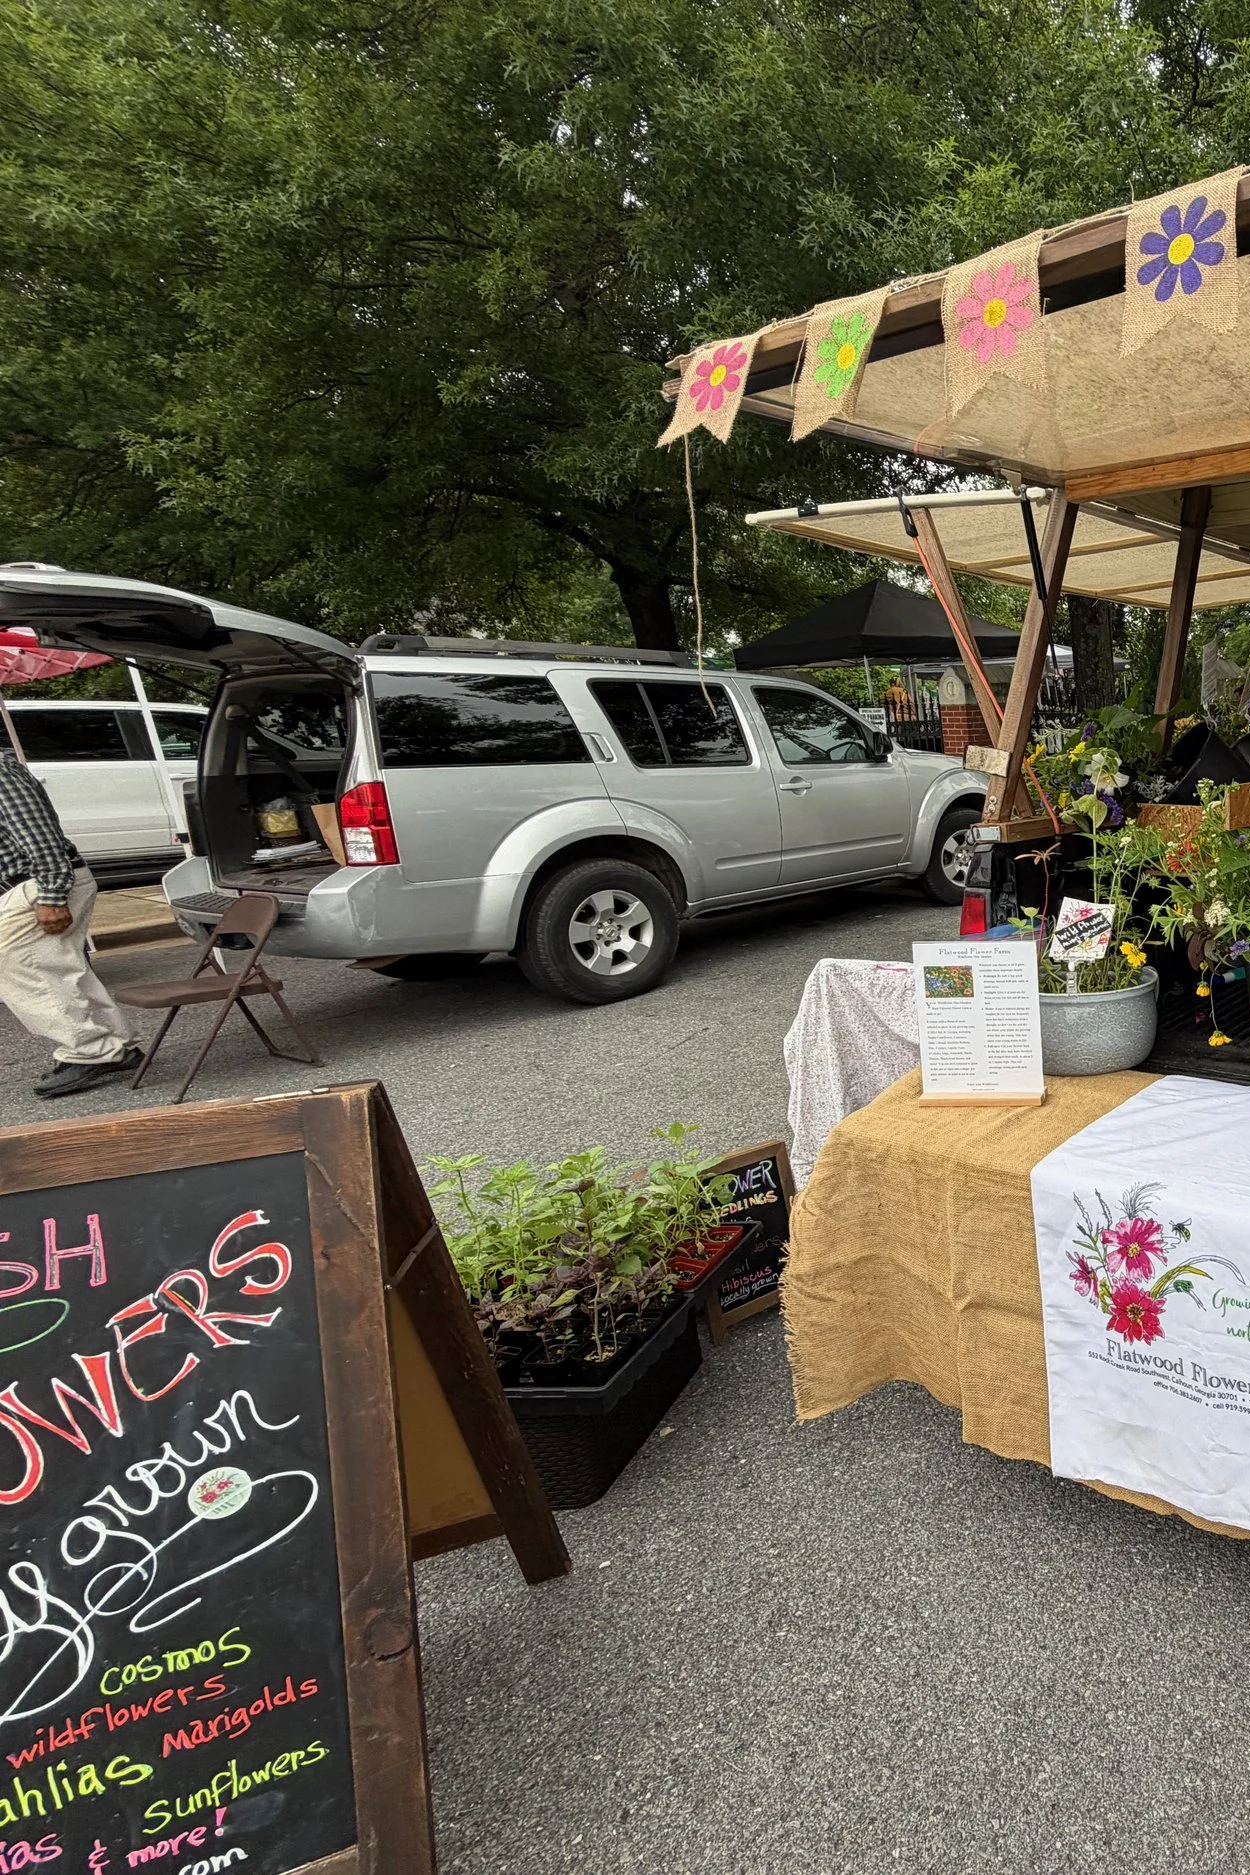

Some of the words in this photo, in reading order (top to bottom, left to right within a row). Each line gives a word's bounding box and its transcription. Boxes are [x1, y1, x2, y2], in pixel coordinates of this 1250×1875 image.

[721, 1266, 772, 1292] Hibiscus
[752, 1273, 779, 1295] grown
[1106, 1338, 1184, 1376] Flatwood
[1126, 1364, 1140, 1374] Road
[1217, 1393, 1238, 1401] 30701
[61, 1390, 300, 1616] grown
[6, 1674, 227, 1769] wildflowers
